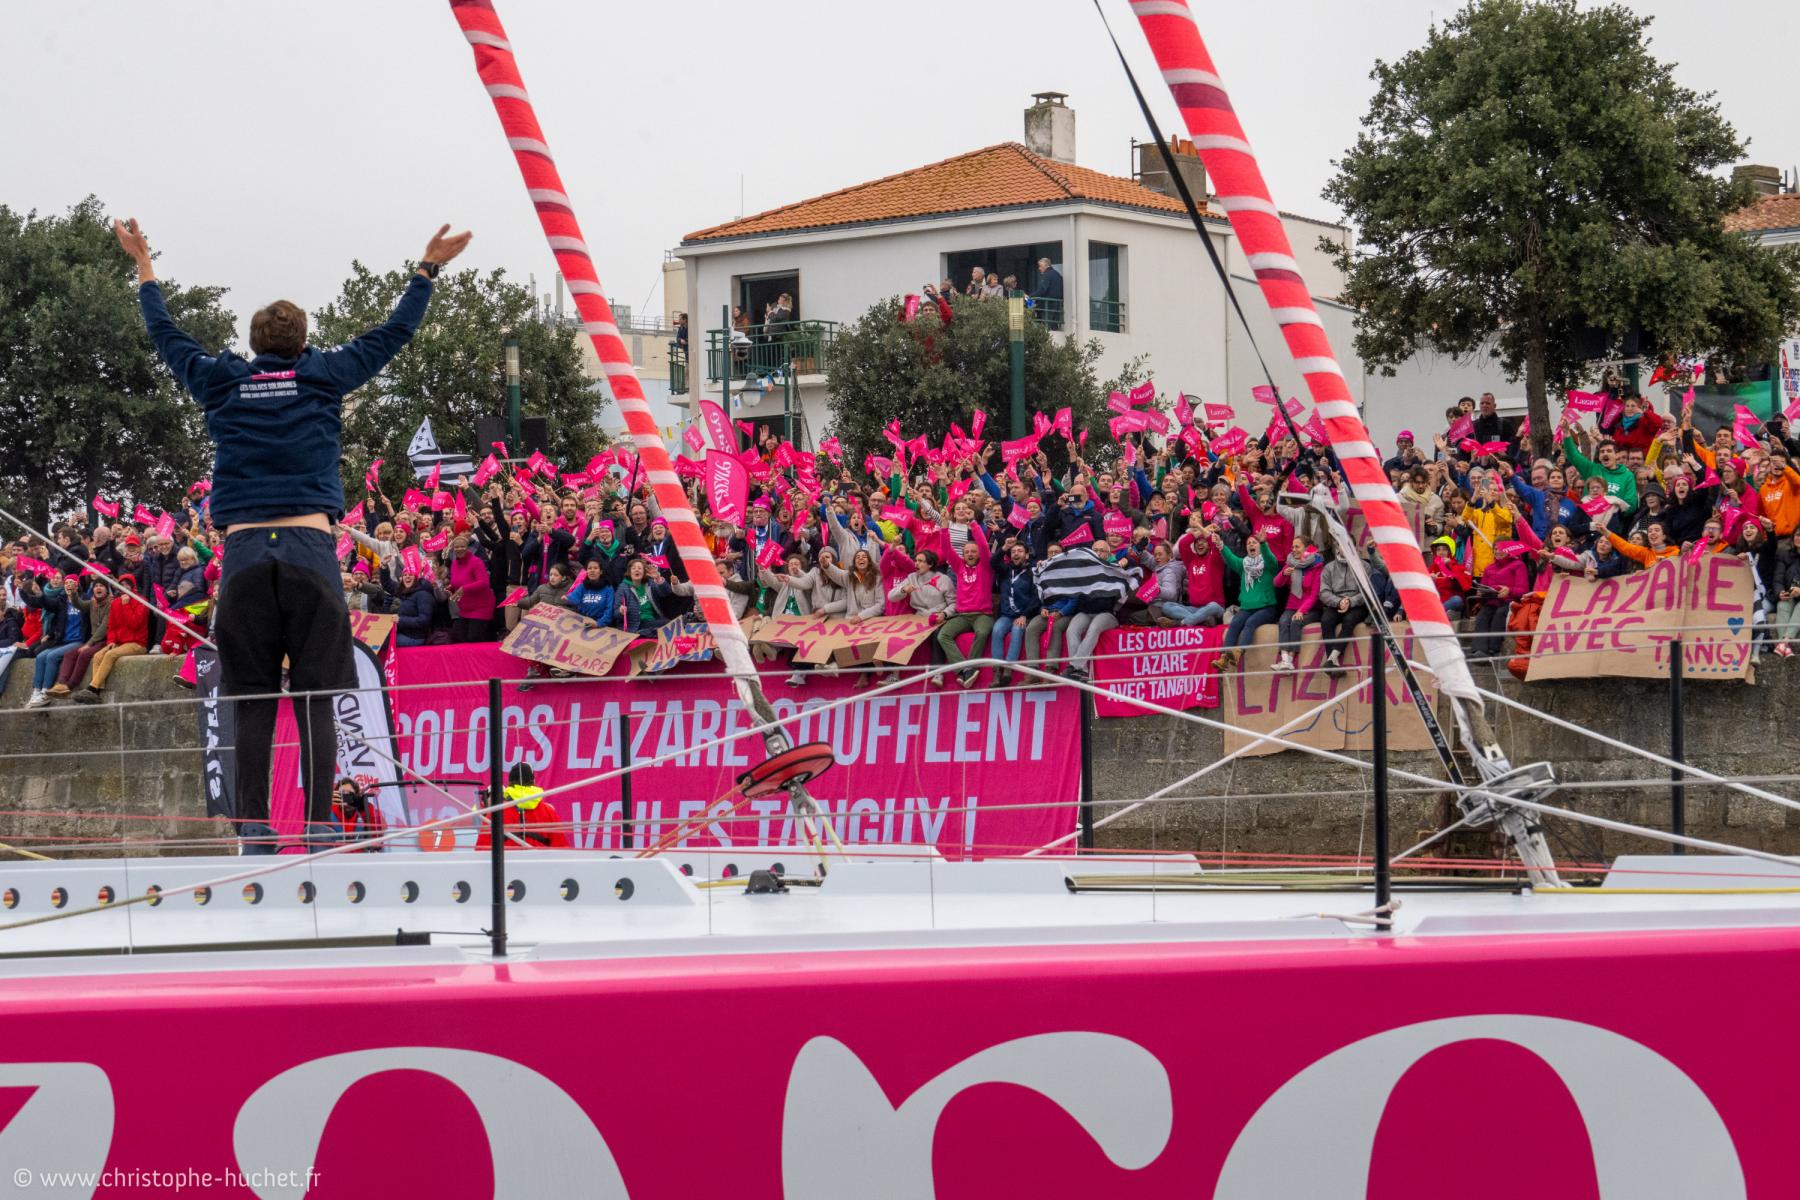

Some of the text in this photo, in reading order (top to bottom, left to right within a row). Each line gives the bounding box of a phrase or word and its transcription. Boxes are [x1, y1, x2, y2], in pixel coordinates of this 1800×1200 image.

[774, 619, 933, 638] TANGUY
[1118, 628, 1205, 653] LES COLOCS
[1535, 616, 1646, 659] AVEC
[1133, 652, 1189, 676] LAZARE
[1107, 681, 1146, 703] AVEC
[566, 699, 751, 770] LAZARE
[1413, 689, 1447, 749] ALL PURPOSE
[752, 796, 950, 847] TANGUY
